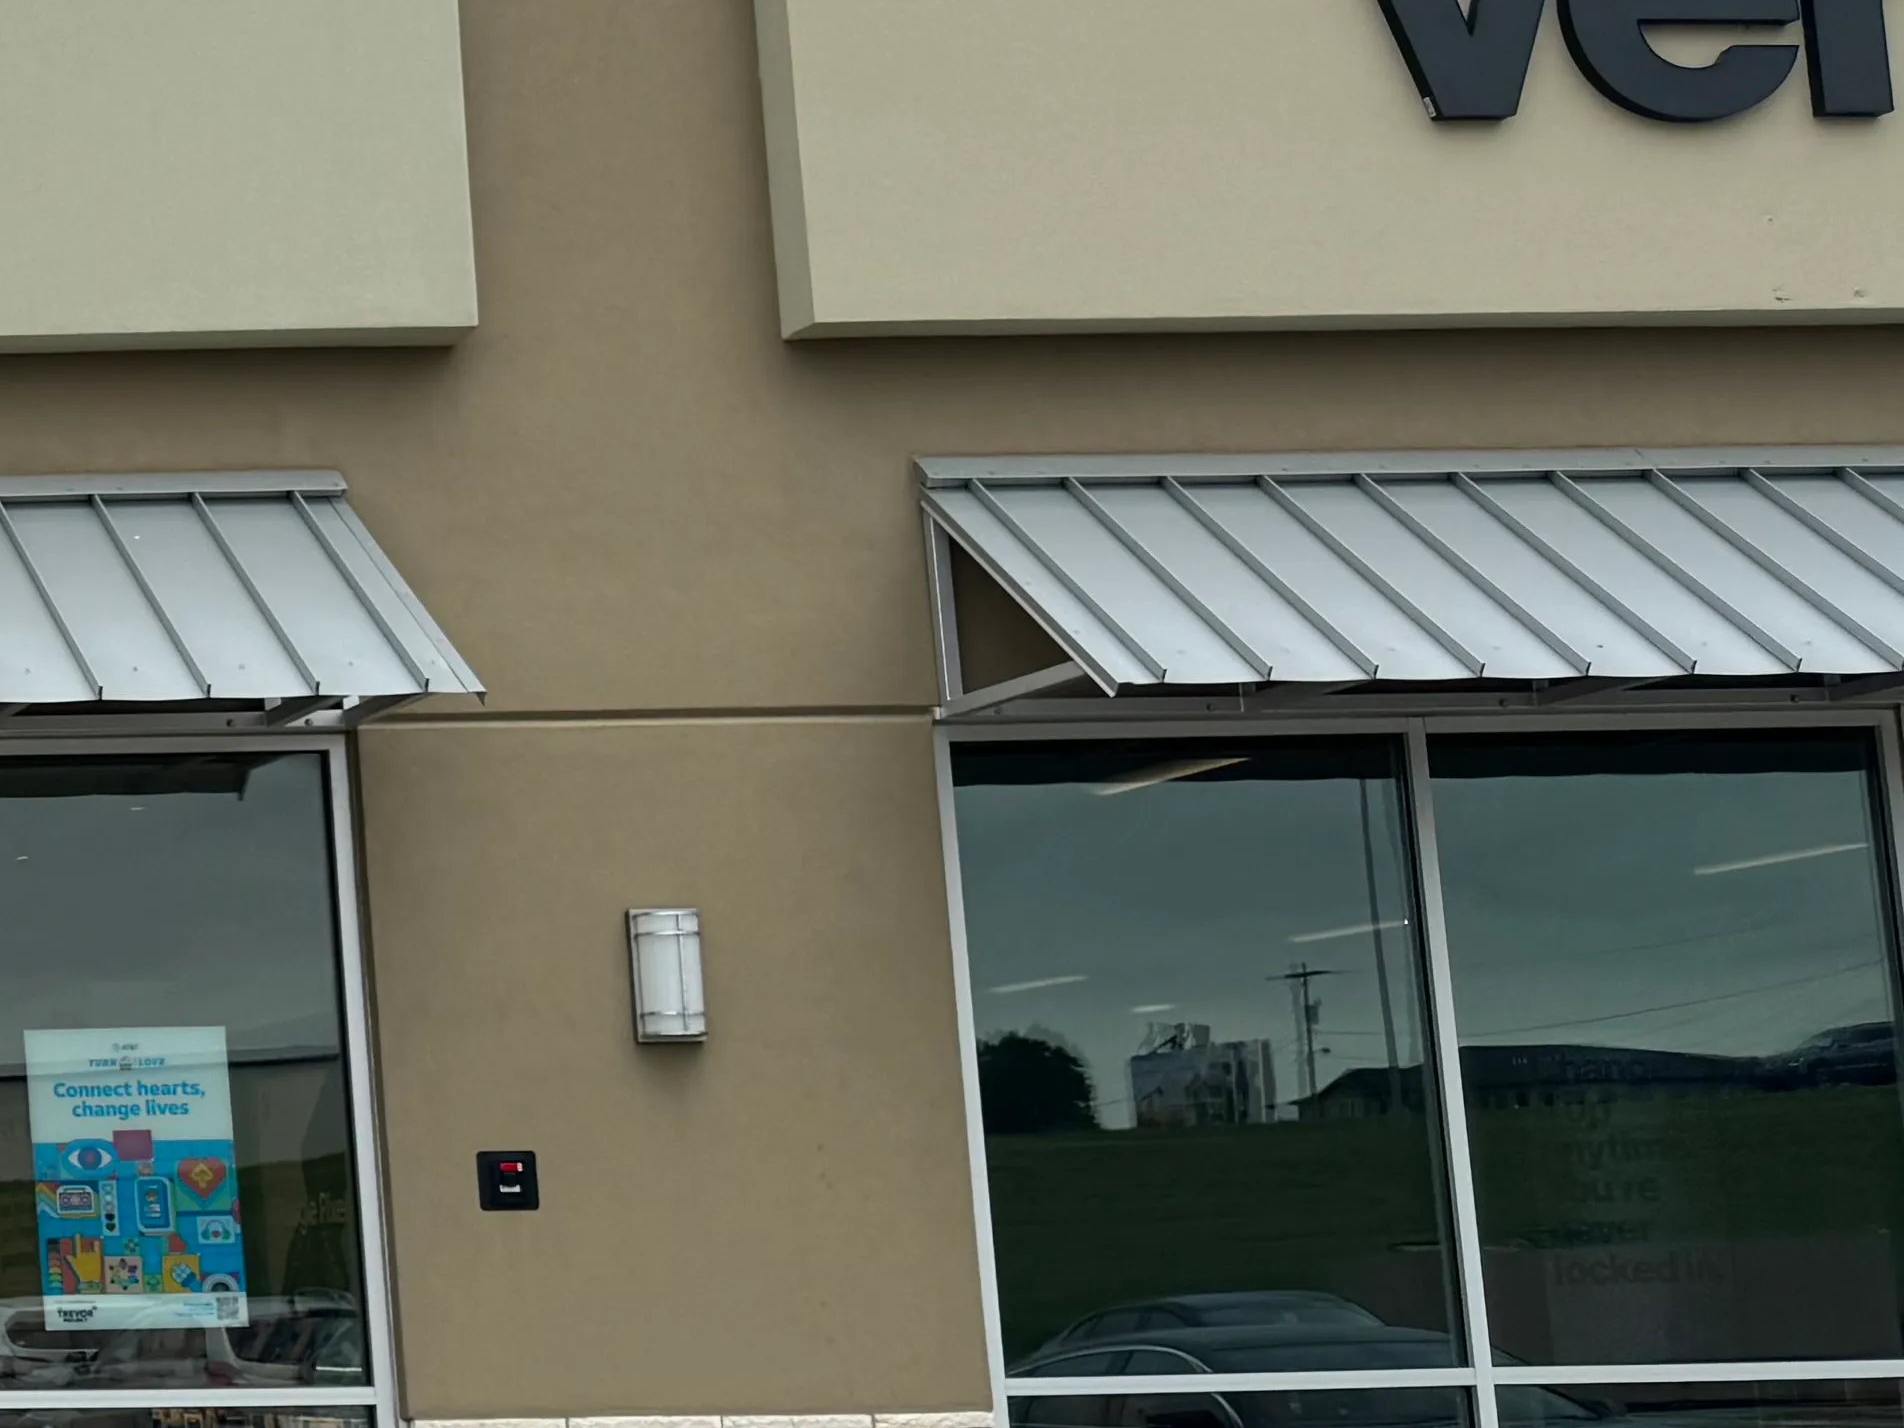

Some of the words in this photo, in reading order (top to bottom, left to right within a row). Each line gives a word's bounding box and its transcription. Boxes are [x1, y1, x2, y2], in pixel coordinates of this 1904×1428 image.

[53, 1082, 132, 1098] Connect
[137, 1080, 205, 1099] hearts,
[72, 1101, 141, 1120] change
[145, 1100, 190, 1116] lives
